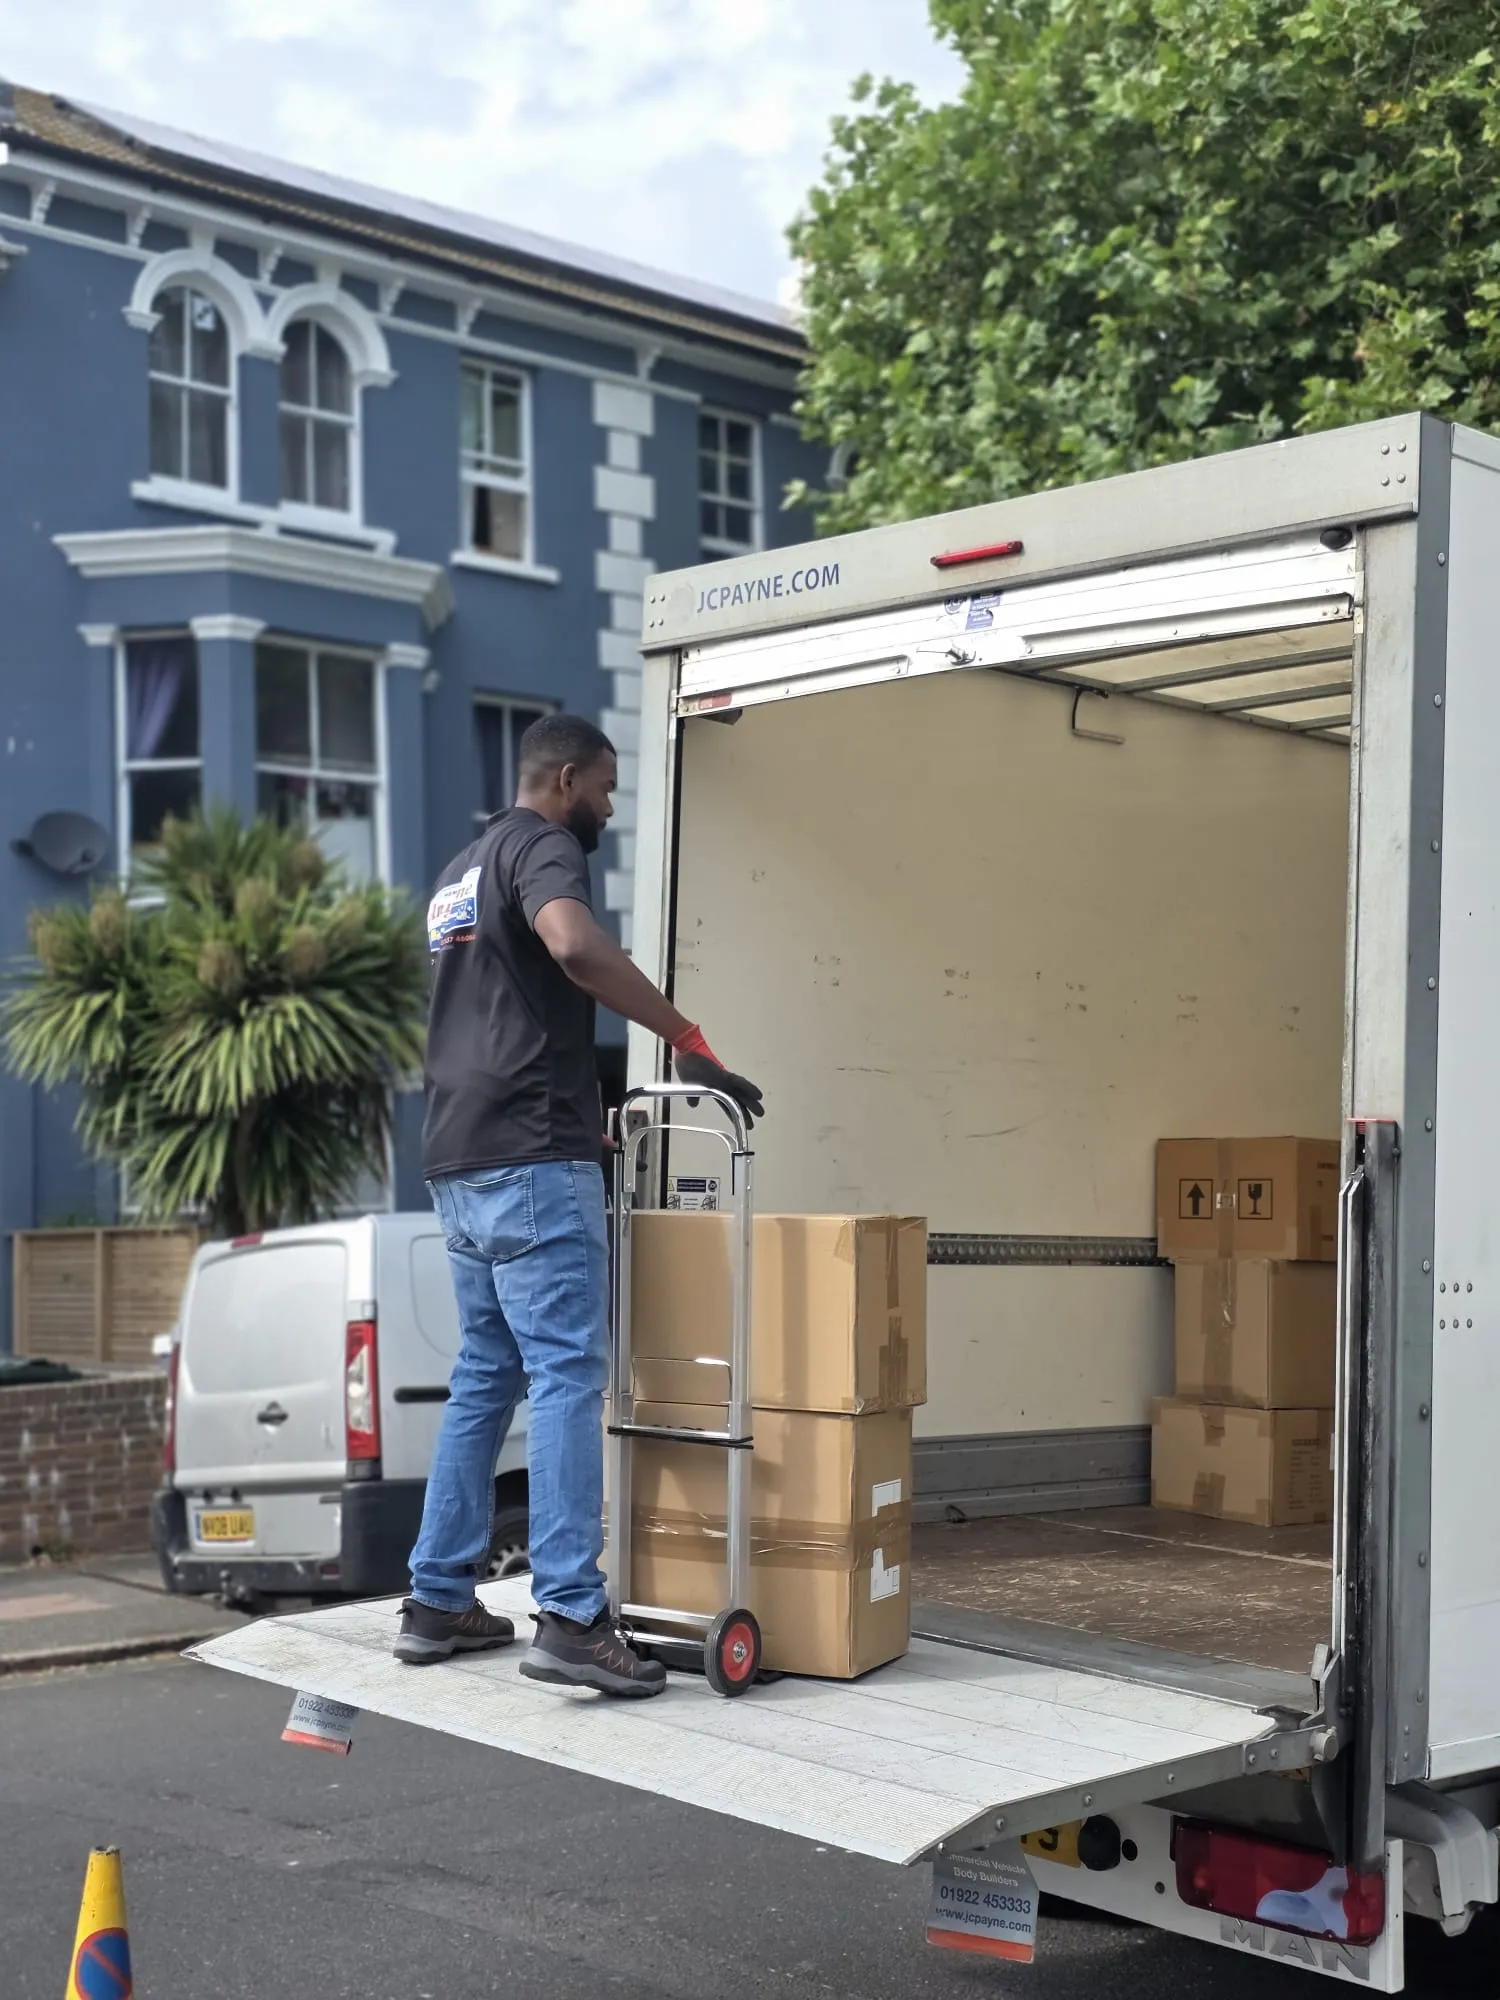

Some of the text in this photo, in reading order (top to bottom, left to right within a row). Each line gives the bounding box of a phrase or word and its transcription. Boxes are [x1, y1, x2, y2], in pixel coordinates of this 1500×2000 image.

[697, 563, 840, 613] JCPAYNE.COM
[299, 1698, 323, 1713] 01922
[953, 1866, 1018, 1887] Body Builders
[991, 1860, 1026, 1875] Vehicle
[940, 1885, 1031, 1914] 01922 453333
[1220, 1917, 1370, 1981] MAN
